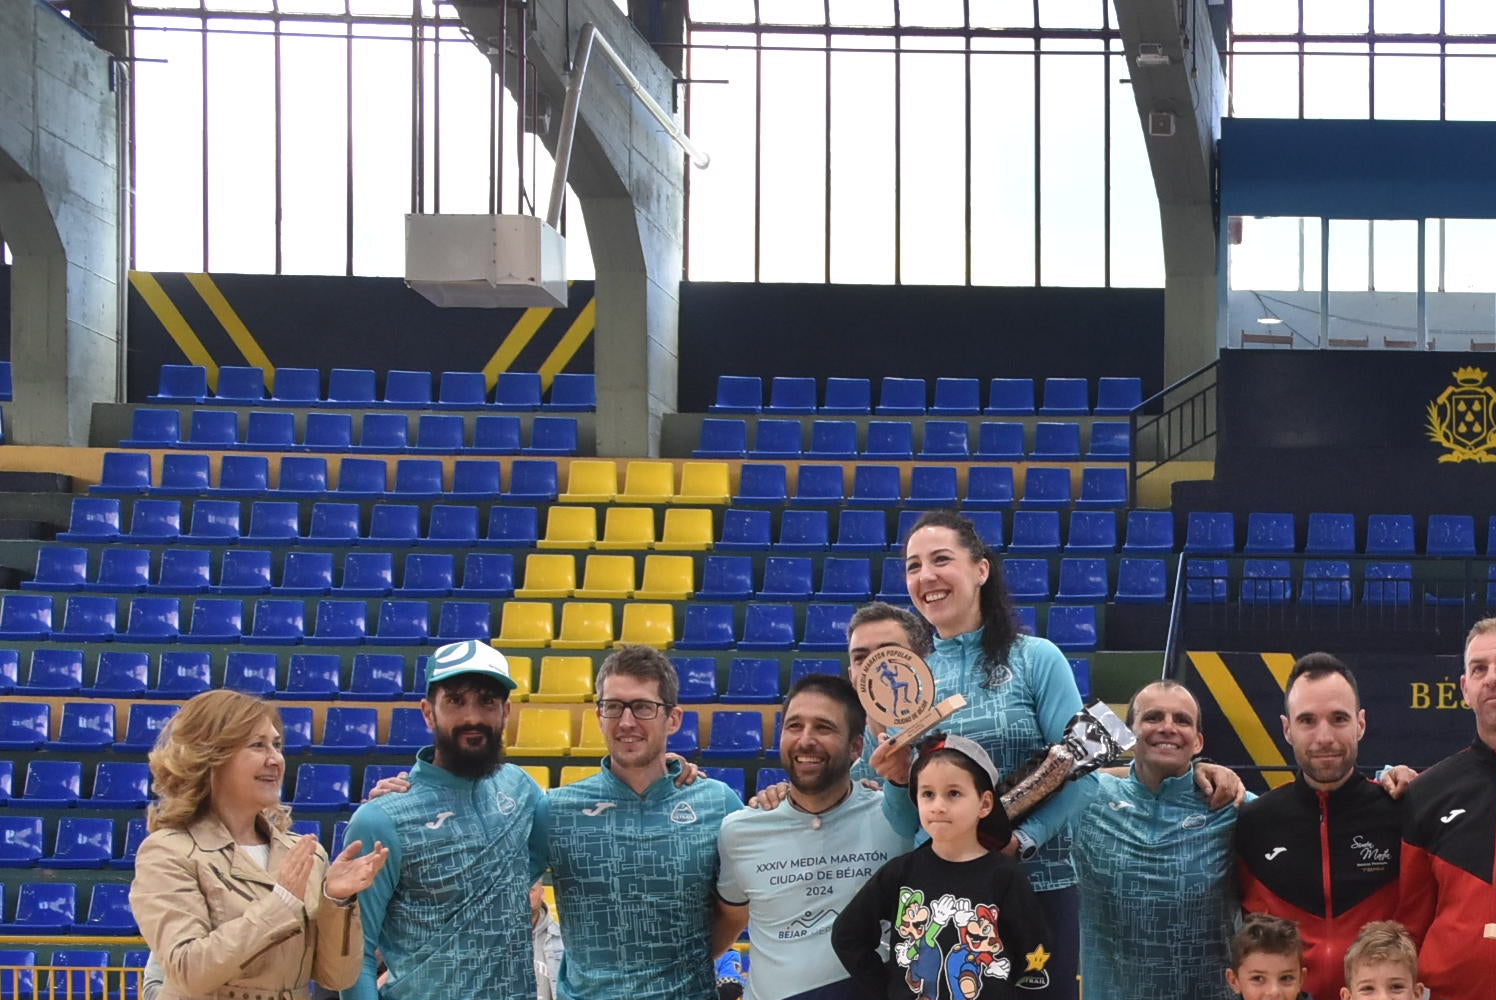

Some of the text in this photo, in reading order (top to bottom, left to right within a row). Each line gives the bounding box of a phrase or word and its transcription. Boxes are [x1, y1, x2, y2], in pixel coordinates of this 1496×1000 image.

[756, 850, 888, 873] XXXIV MEDIA MARATÓN
[769, 867, 872, 886] CIUDAD DE BÉJAR
[805, 886, 834, 897] 2024
[778, 926, 807, 939] BÉJAR
